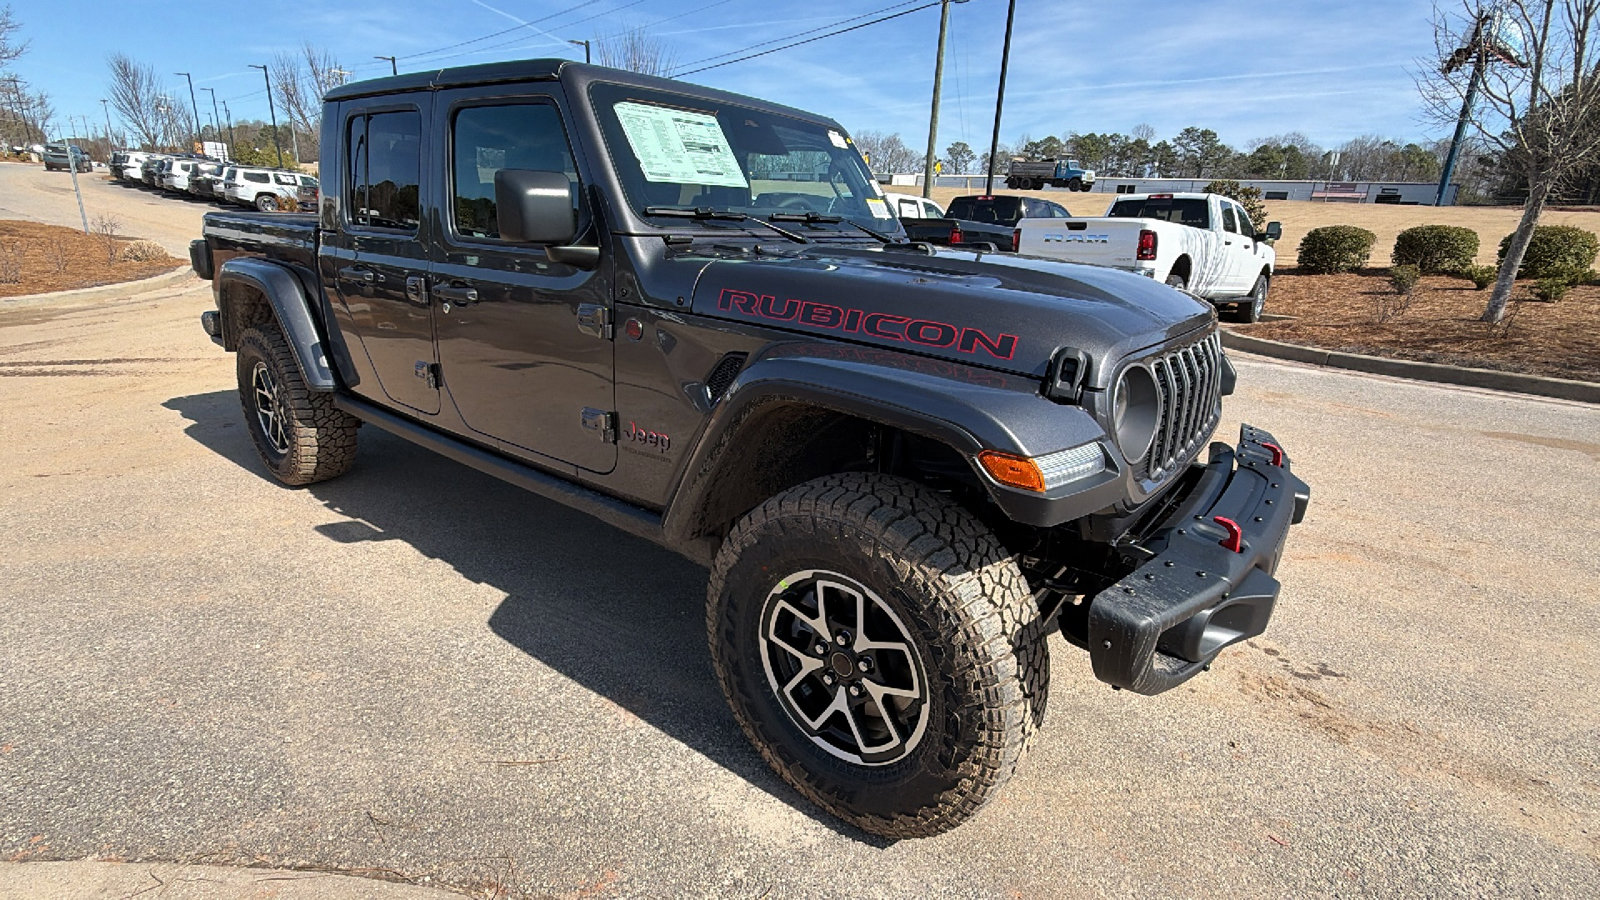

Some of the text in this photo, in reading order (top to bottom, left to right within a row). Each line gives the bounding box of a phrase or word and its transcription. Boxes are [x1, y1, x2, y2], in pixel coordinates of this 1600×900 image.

[1044, 233, 1109, 243] RAM
[717, 288, 1020, 361] RUBICON
[624, 420, 671, 453] Jeep
